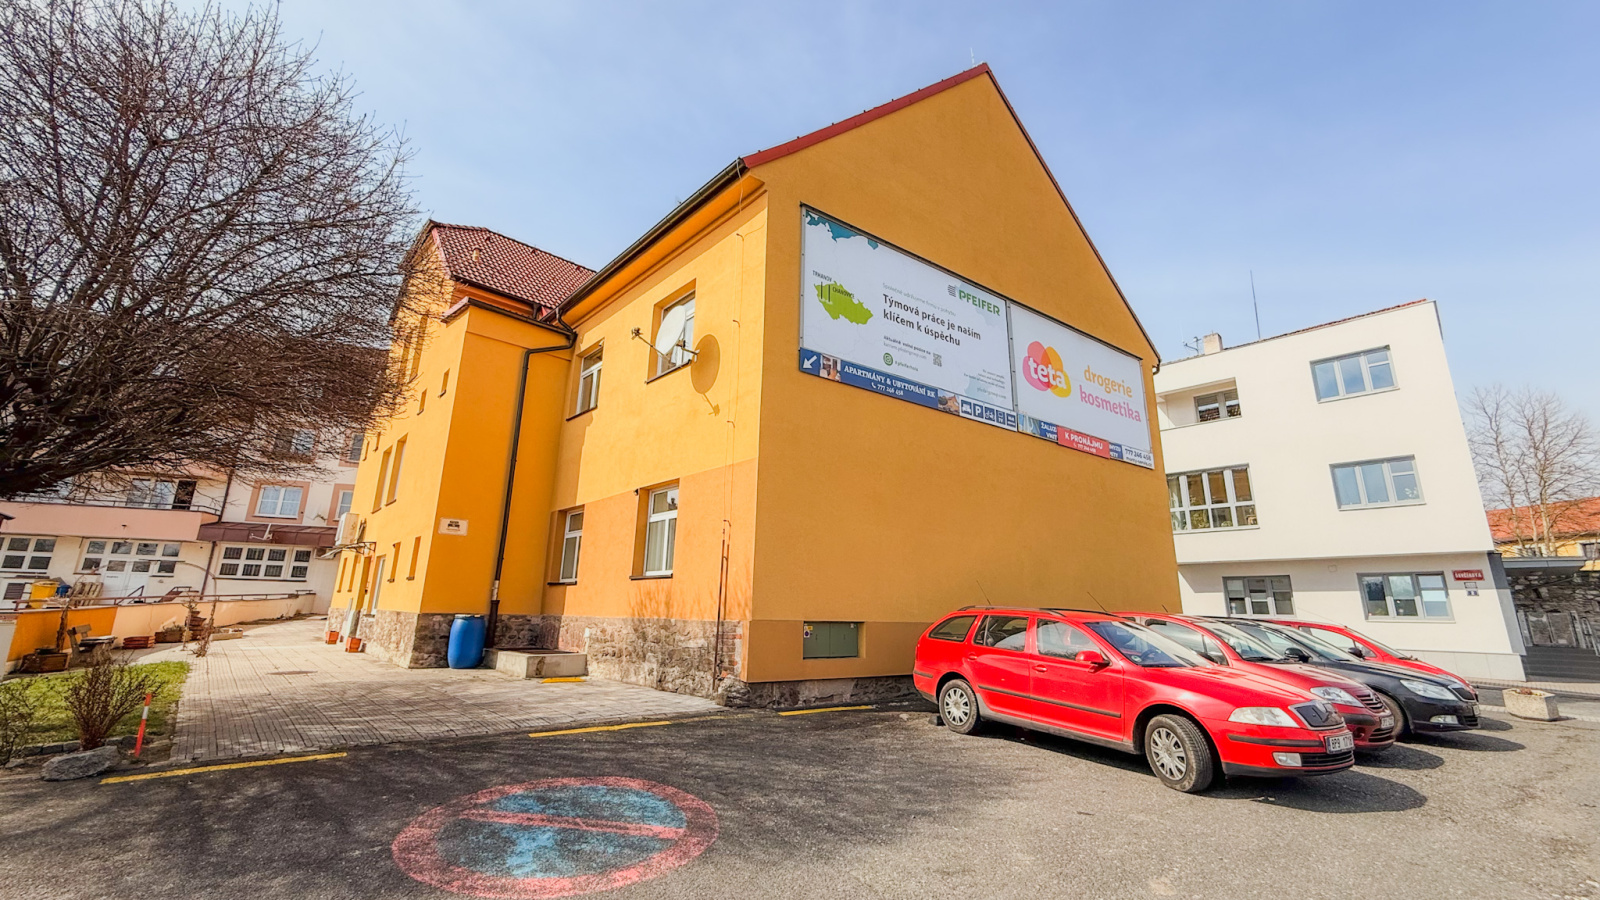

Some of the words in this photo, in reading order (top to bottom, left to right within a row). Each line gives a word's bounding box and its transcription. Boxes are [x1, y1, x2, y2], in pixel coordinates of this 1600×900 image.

[883, 294, 920, 316] Týmová
[922, 312, 946, 326] práce
[947, 320, 955, 330] je
[958, 290, 1000, 316] PFEIFER
[884, 309, 914, 329] klíčem
[916, 321, 922, 332] k
[924, 325, 960, 346] úspěchu
[844, 365, 885, 383] APARTMÁNY
[892, 379, 926, 396] UBYTOVÁNÍ
[927, 390, 936, 398] RK
[1028, 358, 1067, 389] teta
[1084, 364, 1132, 398] drogerie
[1079, 384, 1141, 422] kosmetika
[1064, 432, 1069, 440] K
[1070, 434, 1103, 450] PRONÁJMU
[1125, 448, 1133, 456] 777
